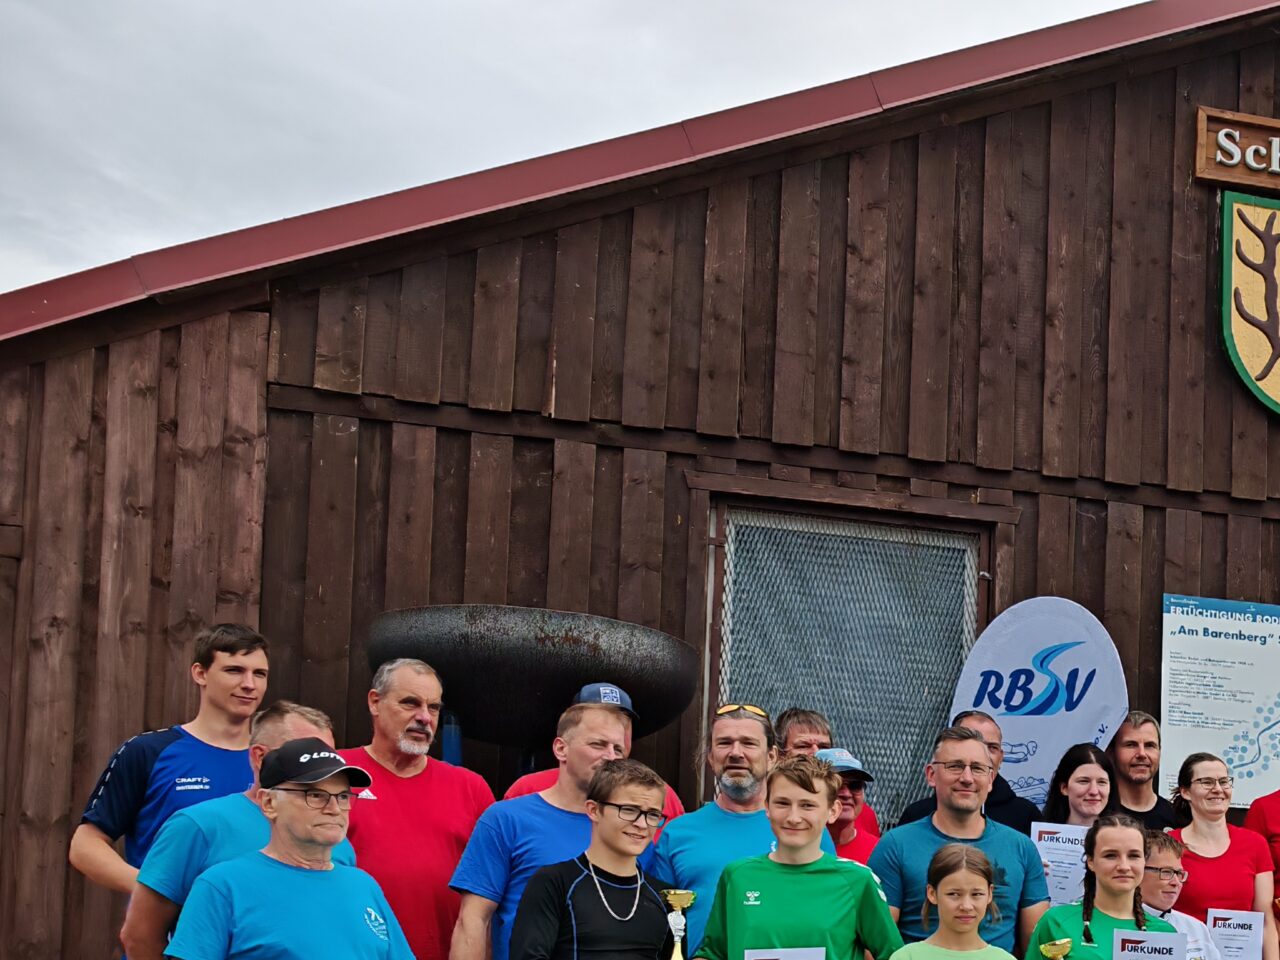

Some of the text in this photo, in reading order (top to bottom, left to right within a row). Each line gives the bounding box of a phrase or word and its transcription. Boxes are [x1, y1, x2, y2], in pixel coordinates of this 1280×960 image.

[1170, 605, 1253, 622] ERTÜCHTIGUNG
[972, 641, 1097, 717] RBSV
[1216, 921, 1253, 931] URKUNDE
[1126, 944, 1174, 956] URKUNDE
